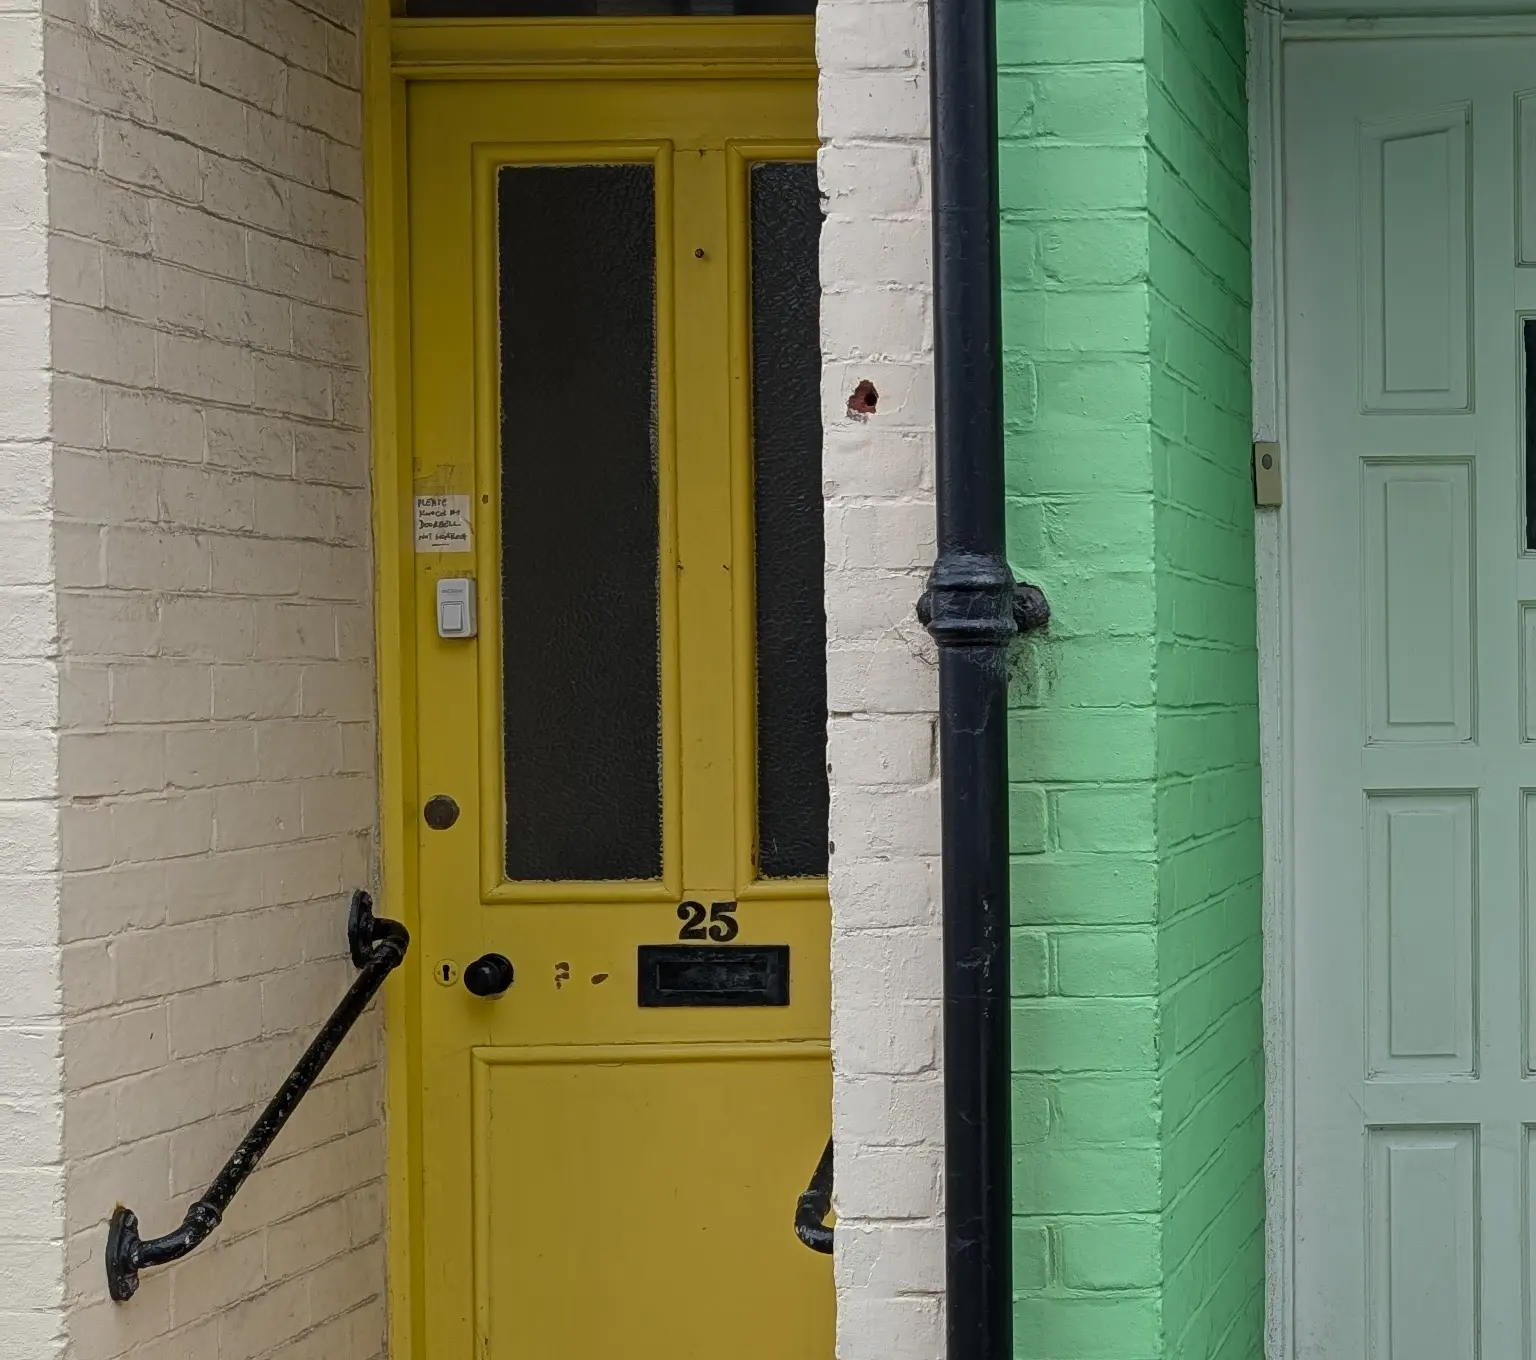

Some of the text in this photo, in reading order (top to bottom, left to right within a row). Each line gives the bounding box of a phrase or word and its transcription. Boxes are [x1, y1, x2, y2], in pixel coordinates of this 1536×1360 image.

[417, 498, 447, 508] PLEASE
[419, 519, 461, 529] DOORBELL
[677, 901, 739, 942] 25
